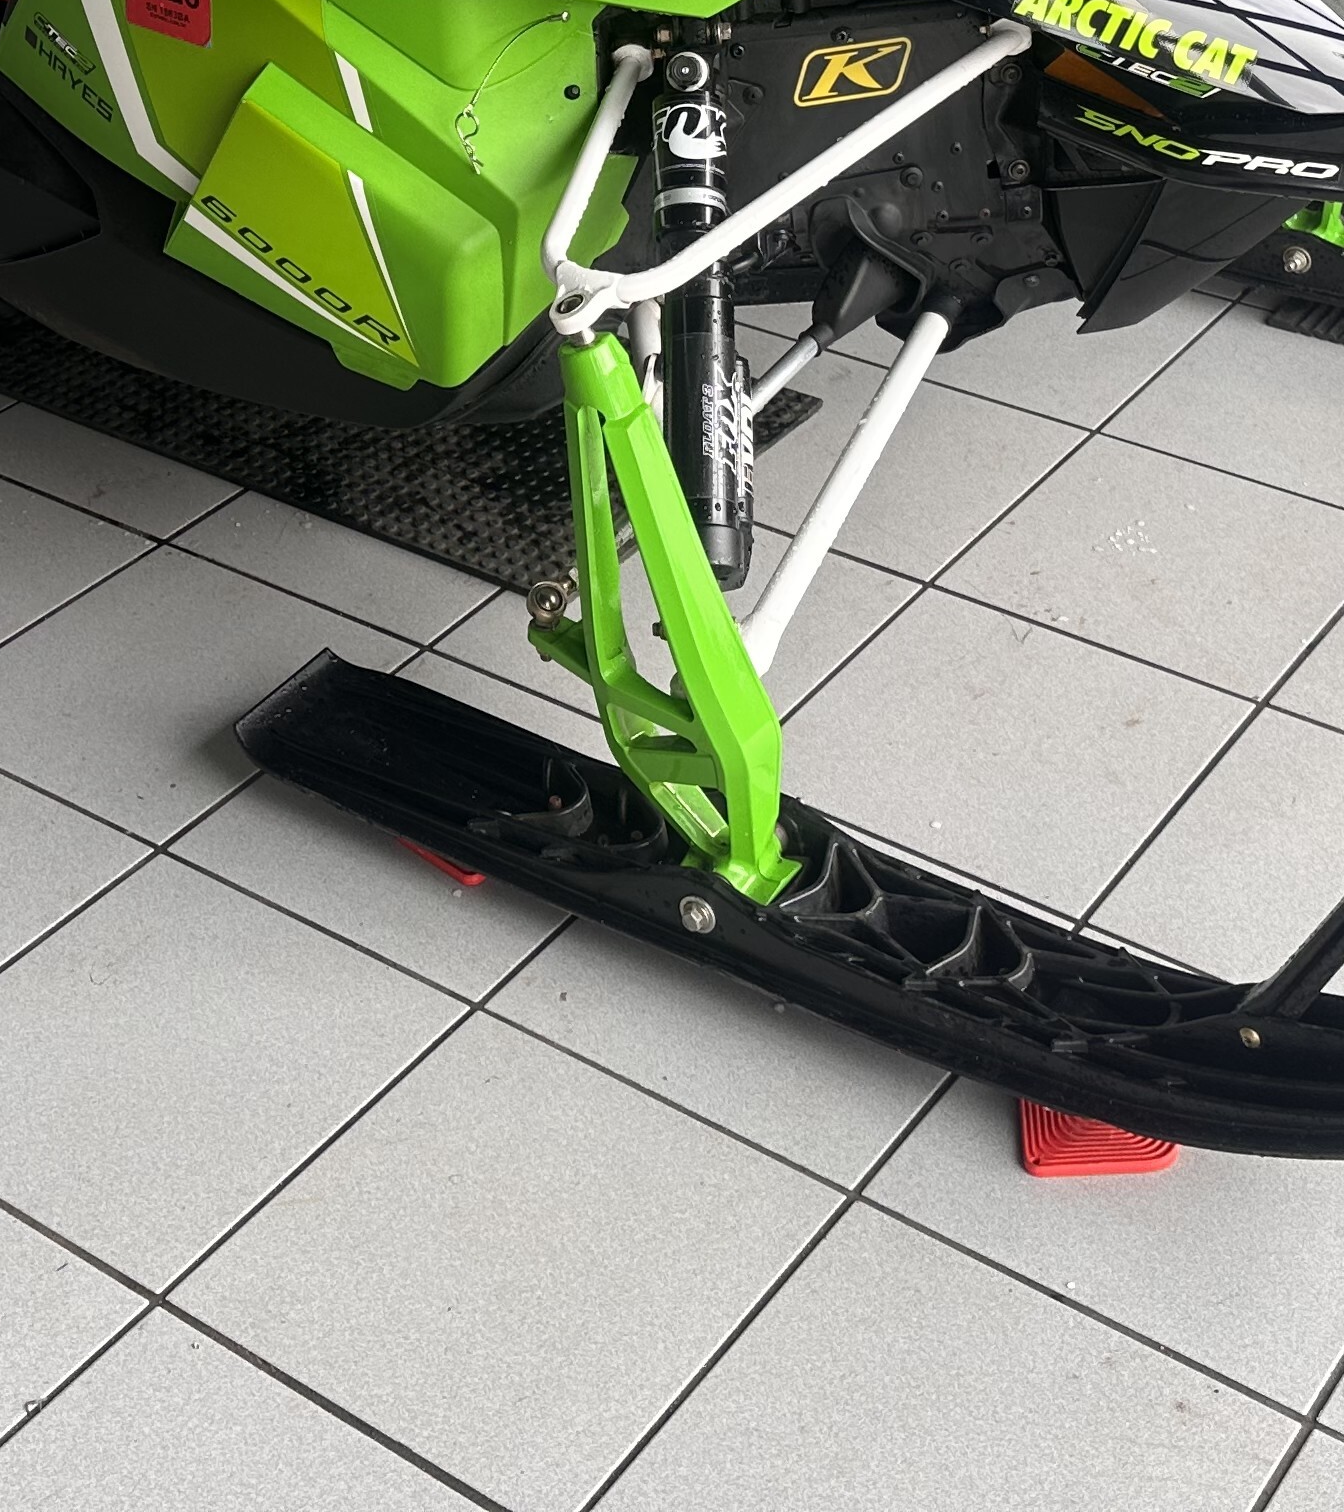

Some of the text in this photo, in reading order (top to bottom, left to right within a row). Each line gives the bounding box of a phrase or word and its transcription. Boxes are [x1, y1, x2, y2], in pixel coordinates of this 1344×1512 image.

[36, 40, 115, 123] HAYES
[1172, 30, 1259, 86] CAT
[199, 194, 403, 346] 6000R
[701, 396, 714, 459] FLOAT
